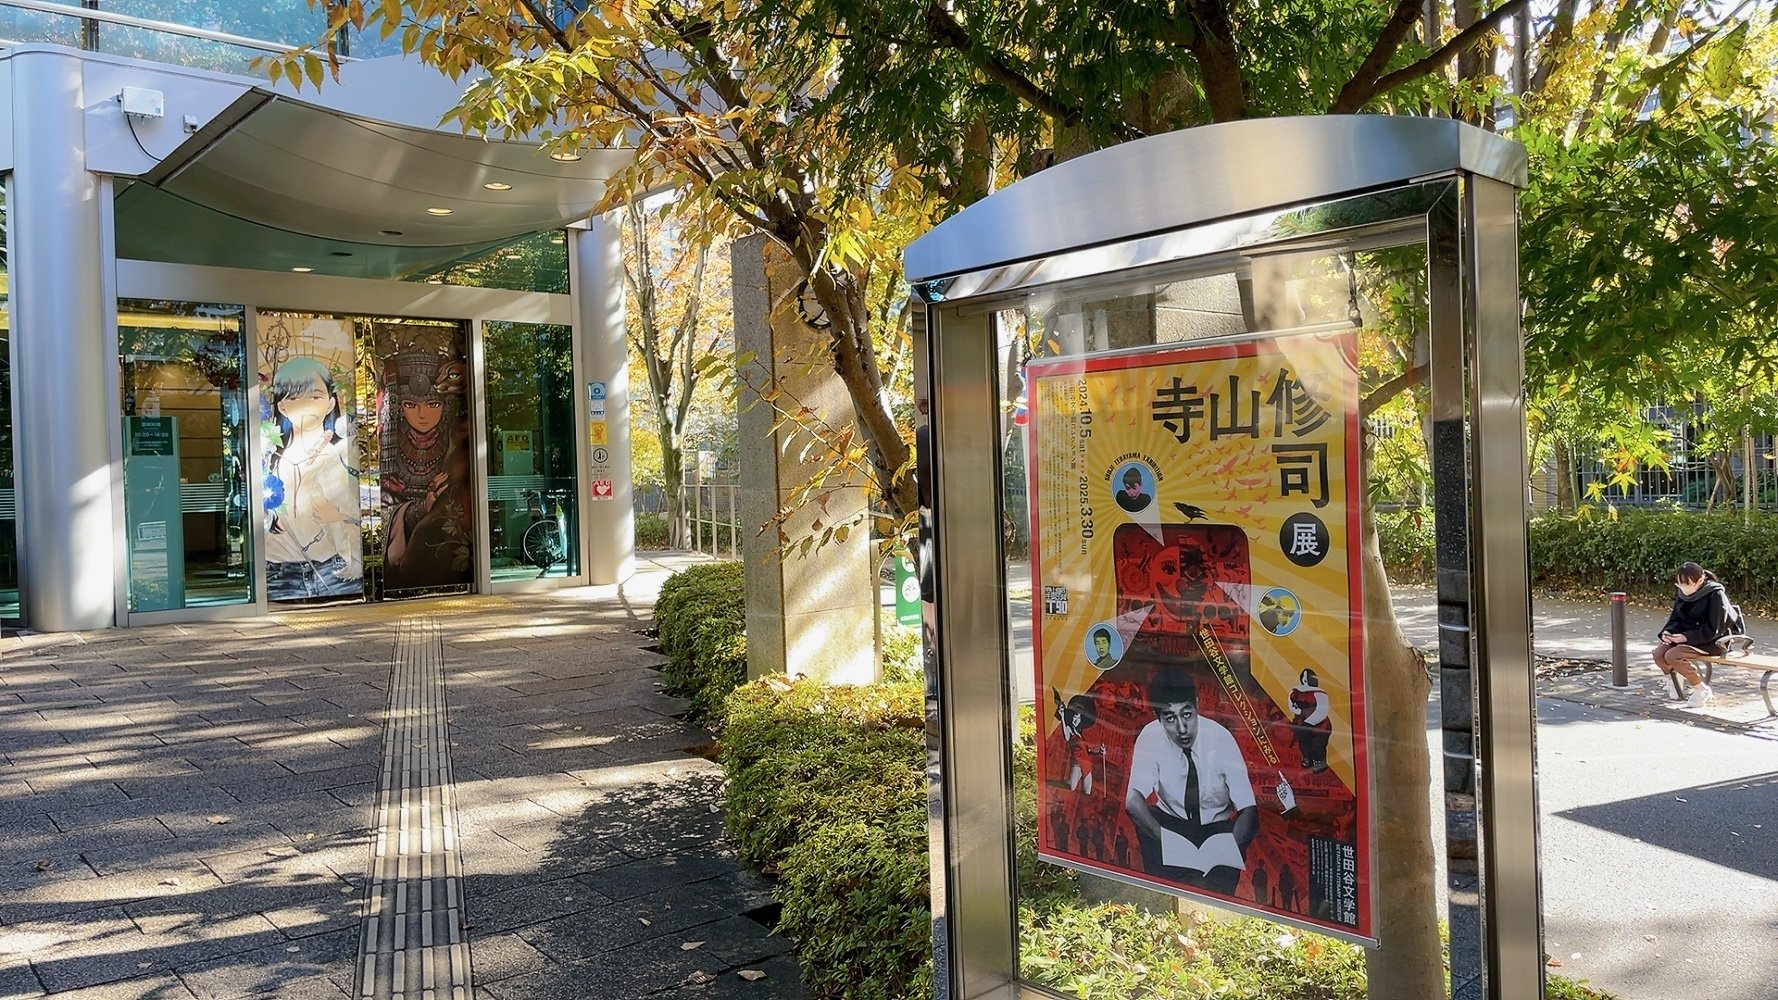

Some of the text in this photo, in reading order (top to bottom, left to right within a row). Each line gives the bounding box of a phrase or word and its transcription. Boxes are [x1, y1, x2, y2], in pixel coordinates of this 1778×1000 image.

[1342, 845, 1356, 926] 世田谷文学館
